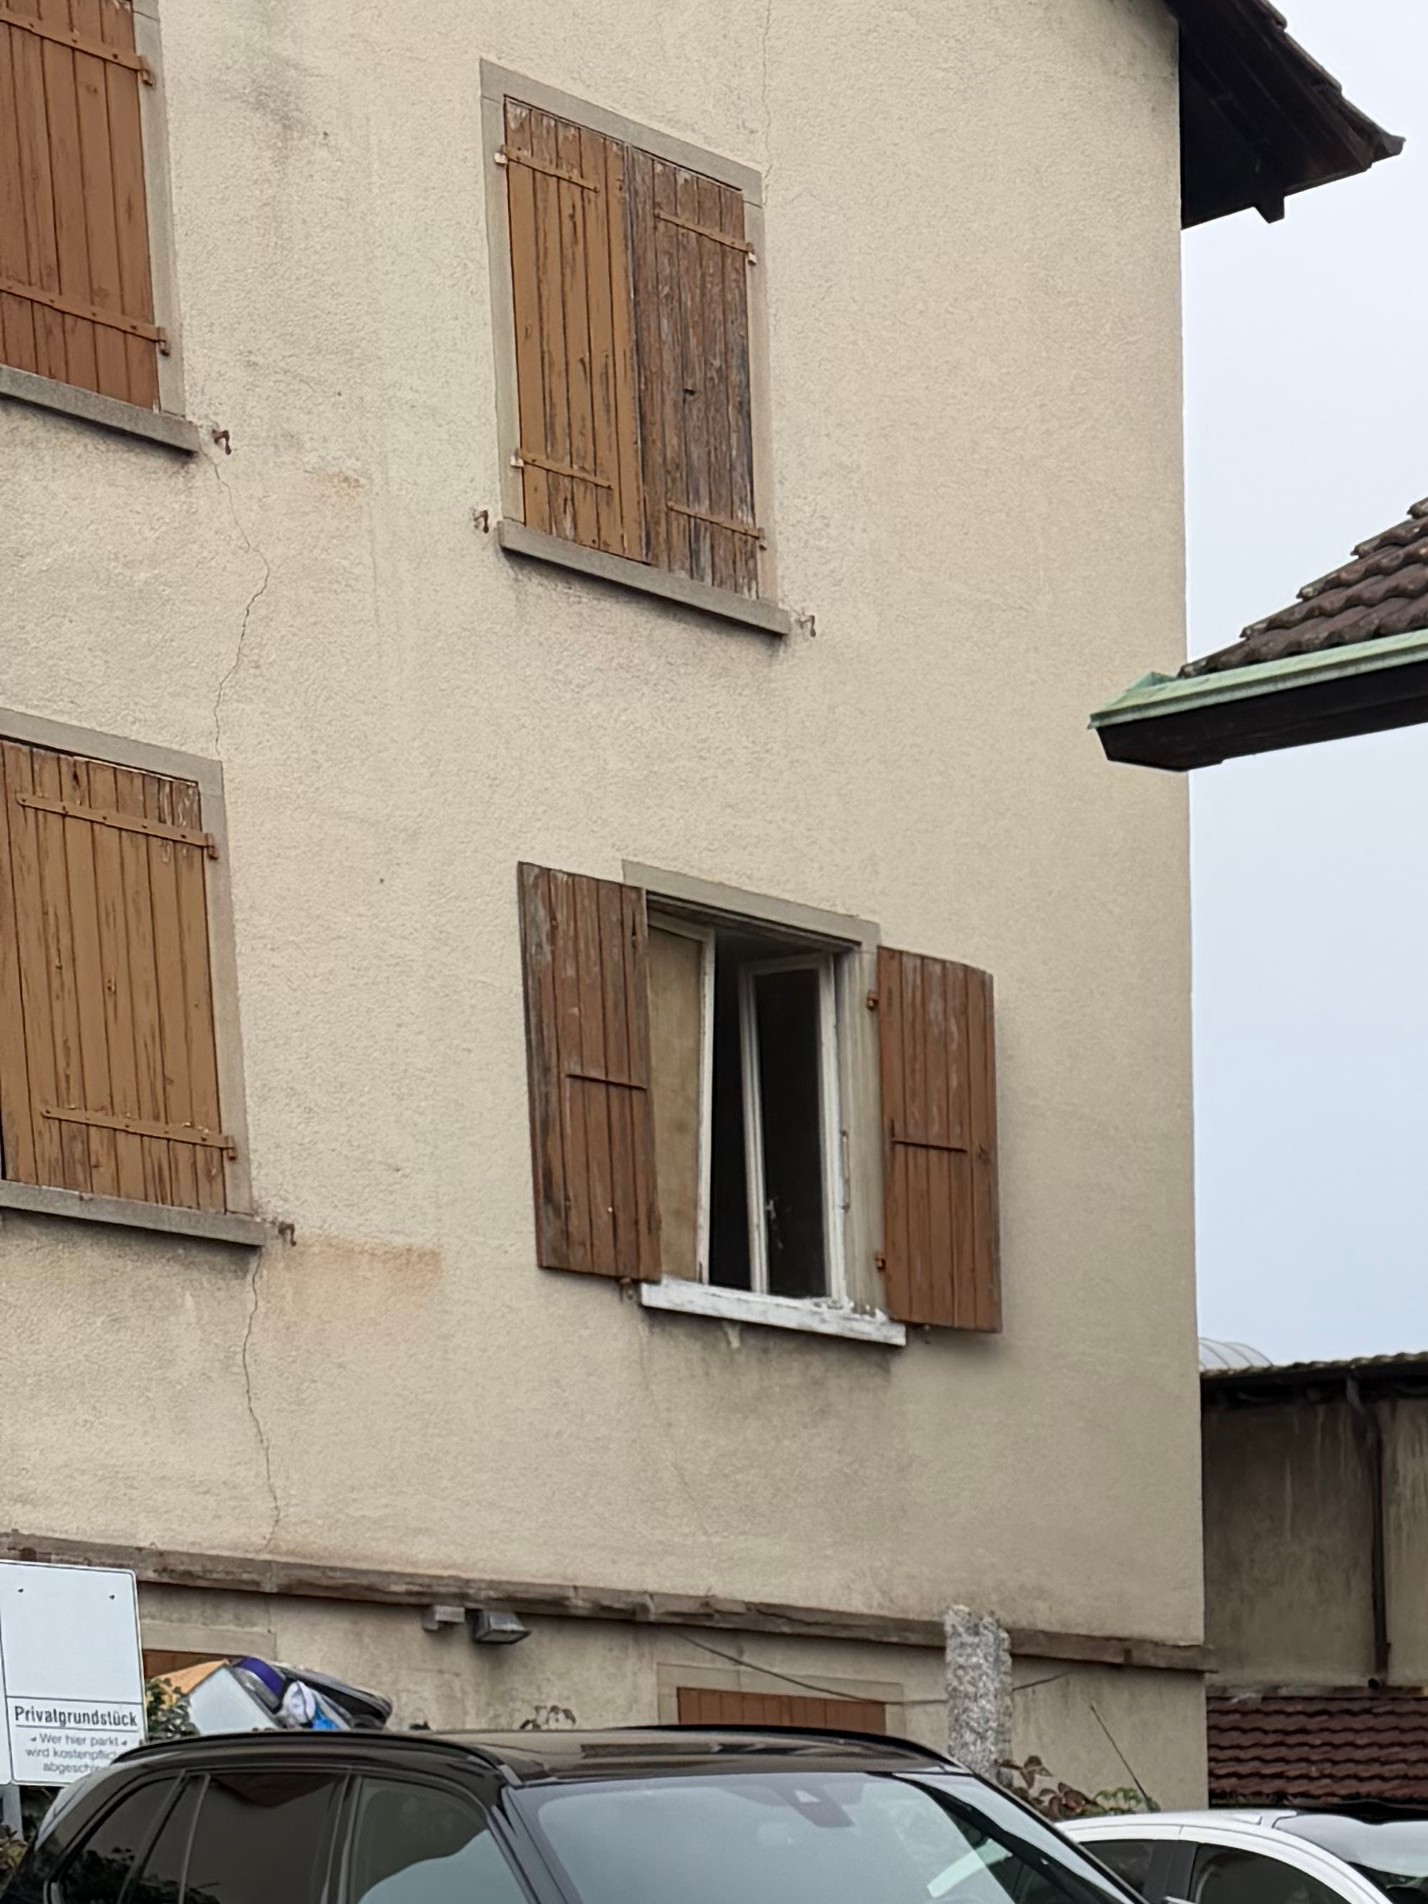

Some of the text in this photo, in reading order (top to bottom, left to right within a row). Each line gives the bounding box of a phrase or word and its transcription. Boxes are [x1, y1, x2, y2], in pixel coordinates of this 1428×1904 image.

[14, 1705, 138, 1727] Privatgrundstück
[39, 1733, 119, 1747] Wer hier parkt
[25, 1748, 50, 1758] wird
